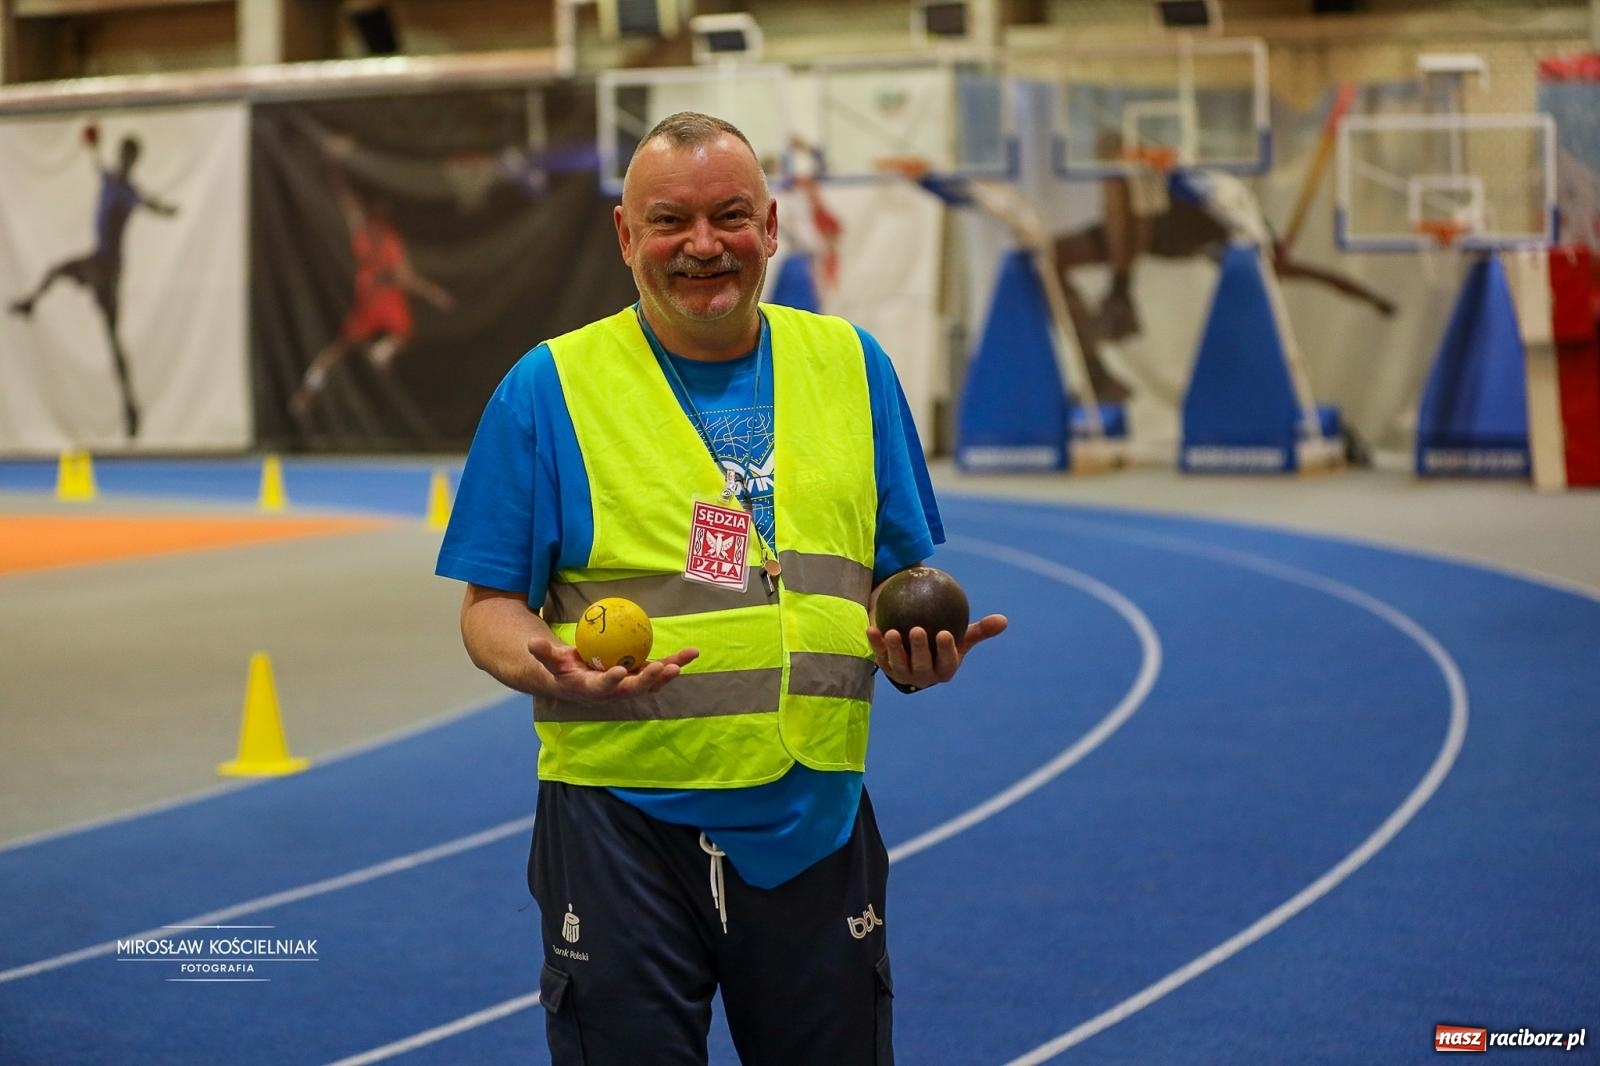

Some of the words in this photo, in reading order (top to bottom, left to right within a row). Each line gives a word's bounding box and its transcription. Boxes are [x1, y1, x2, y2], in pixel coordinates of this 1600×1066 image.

[698, 508, 746, 529] SĘDZIA
[692, 556, 739, 577] PZLA
[569, 950, 589, 961] Polski
